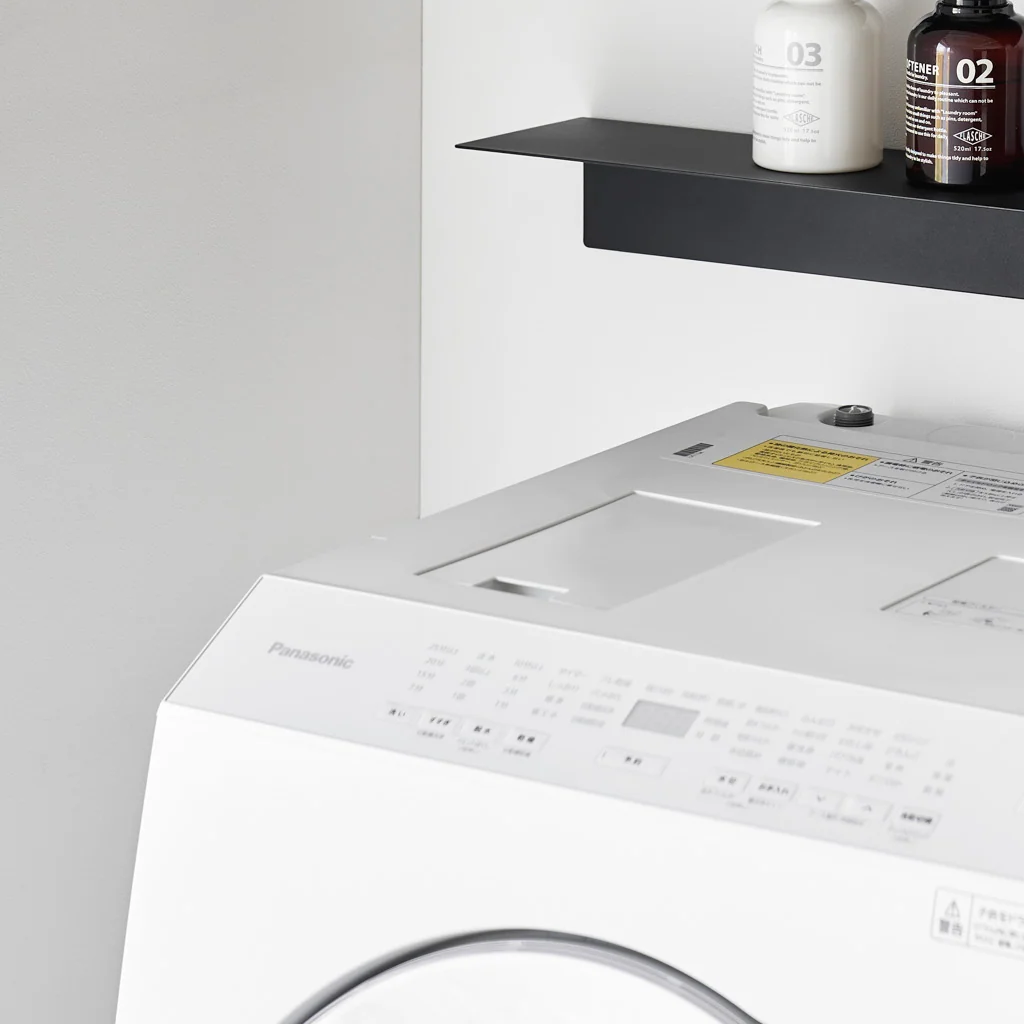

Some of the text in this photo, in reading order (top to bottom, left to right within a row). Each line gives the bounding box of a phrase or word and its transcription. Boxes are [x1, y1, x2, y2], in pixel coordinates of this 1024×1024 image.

[786, 41, 822, 67] 03
[906, 59, 939, 75] FTENER
[956, 58, 994, 84] 02
[267, 640, 355, 670] Panasonic
